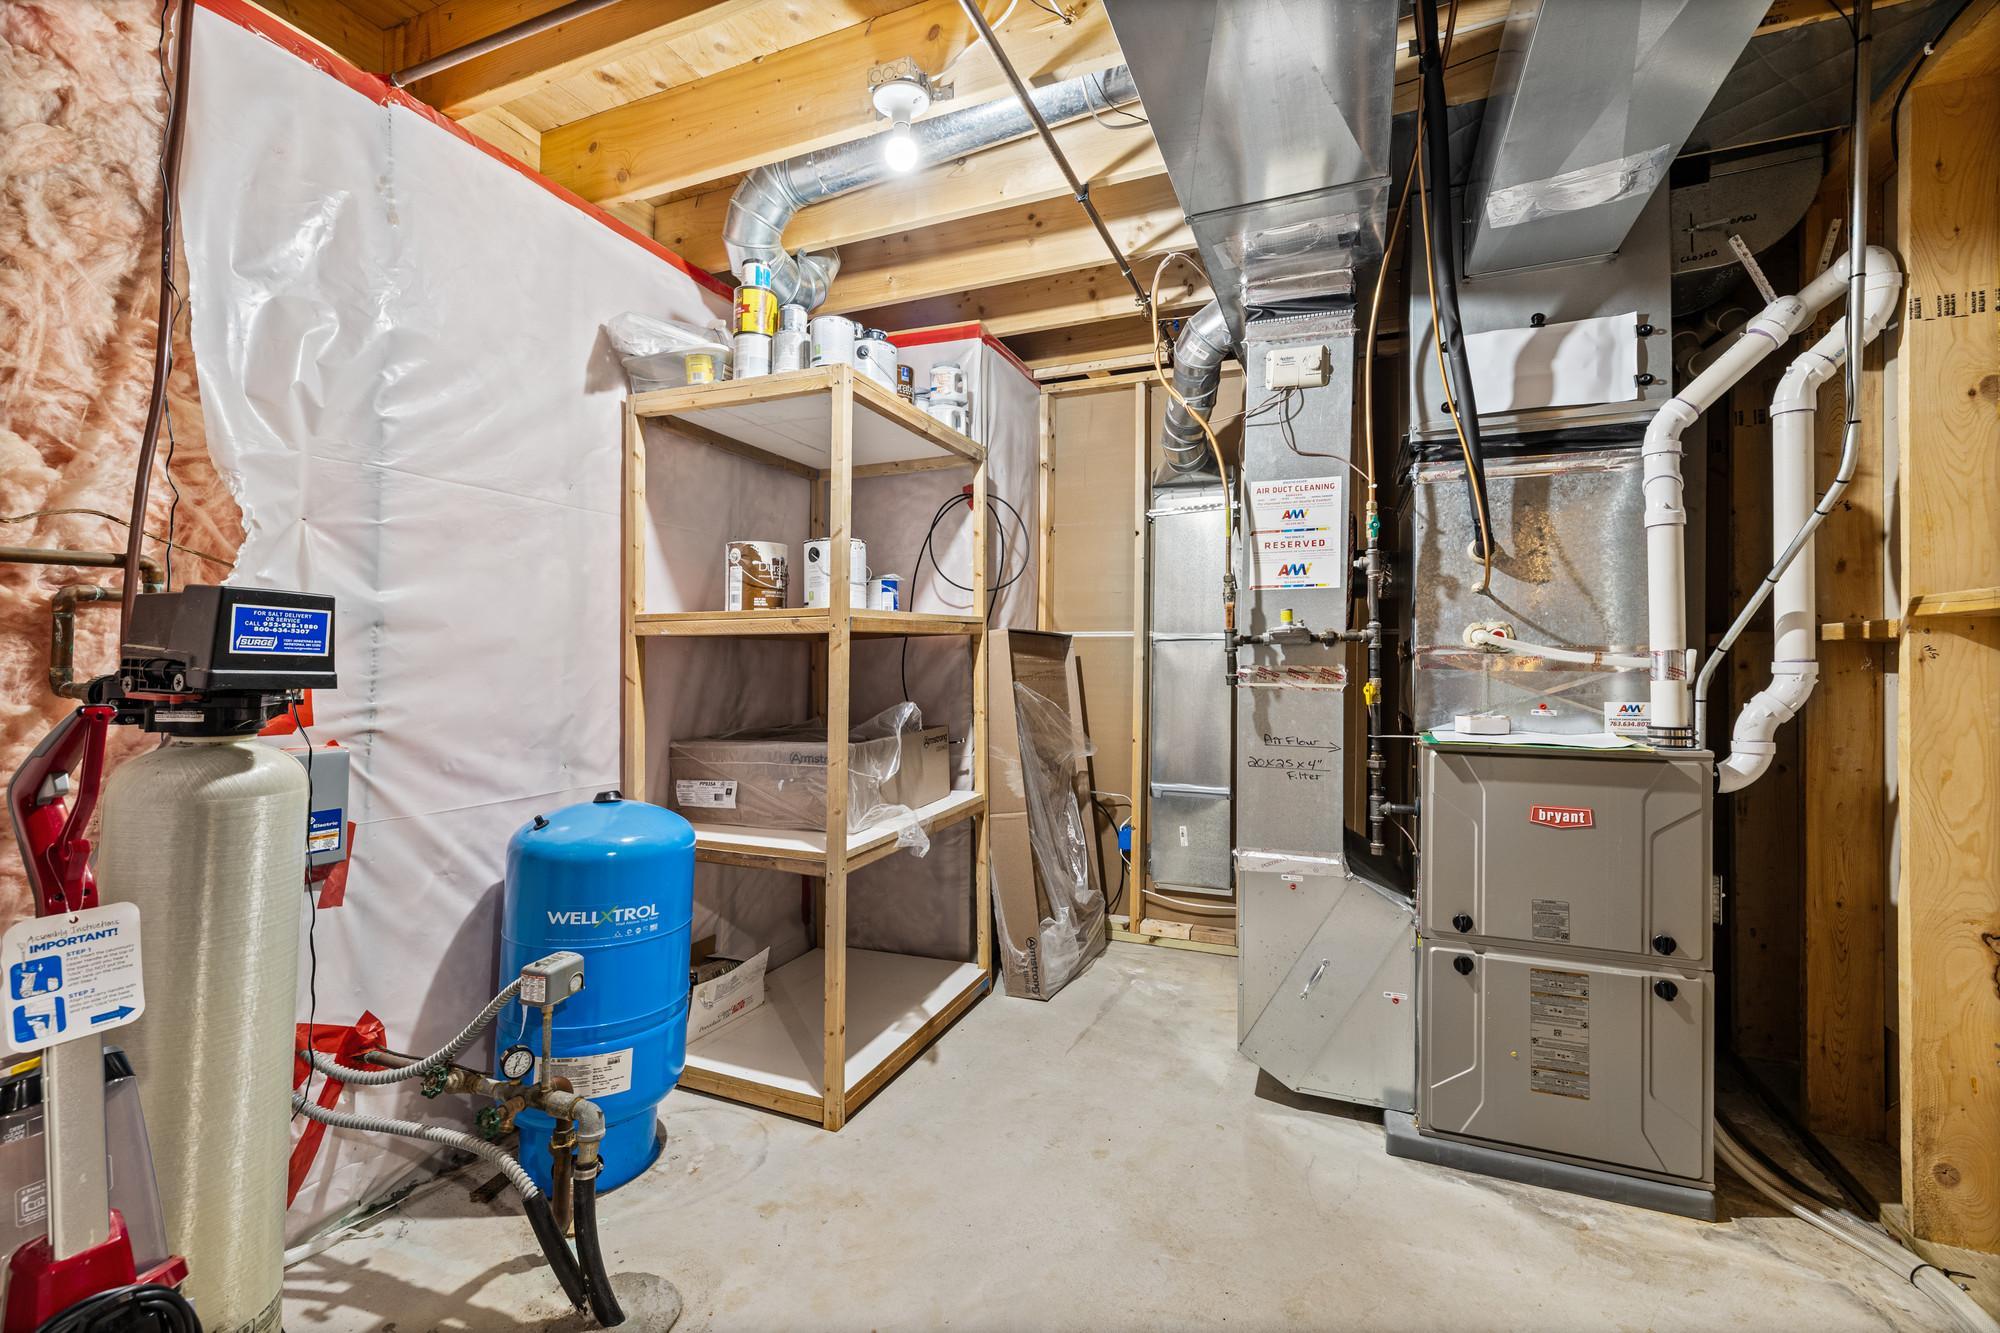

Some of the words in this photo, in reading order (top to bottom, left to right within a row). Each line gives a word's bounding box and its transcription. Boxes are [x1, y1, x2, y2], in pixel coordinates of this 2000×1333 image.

[1730, 213, 1757, 224] OPEN
[1681, 249, 1718, 263] CLOSED
[1256, 487, 1270, 495] AIR
[1272, 485, 1292, 494] DUCT
[1294, 482, 1336, 492] CLEANING
[1264, 539, 1326, 550] RESERVED
[240, 638, 274, 647] SURGE
[1286, 770, 1322, 781] Filter
[1538, 808, 1585, 824] bryant
[27, 928, 67, 943] Assembly
[71, 919, 120, 935] Instructions
[29, 927, 119, 954] IMPORTANT!
[66, 948, 86, 957] STEP
[1026, 936, 1040, 994] Armstrong
[68, 990, 89, 999] STEP
